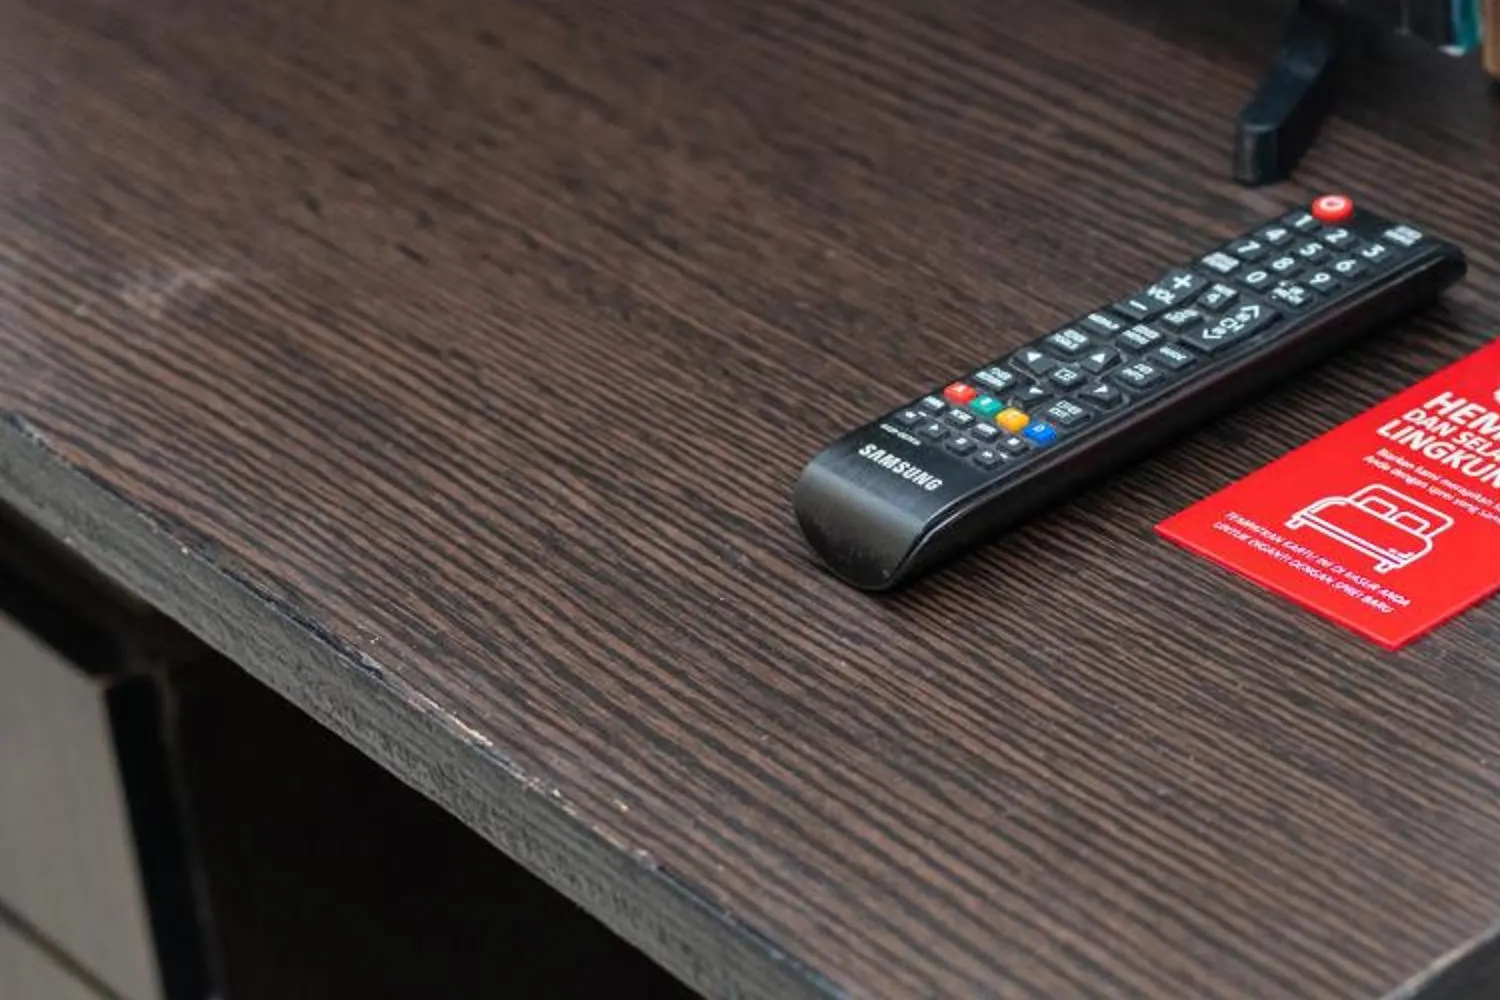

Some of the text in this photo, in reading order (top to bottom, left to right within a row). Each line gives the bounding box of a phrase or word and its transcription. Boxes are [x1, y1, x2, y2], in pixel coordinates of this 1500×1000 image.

[1295, 214, 1312, 229] 1
[1325, 228, 1349, 243] 2
[1237, 240, 1262, 254] 7
[1300, 242, 1323, 256] 5
[1362, 243, 1386, 258] 3
[1271, 257, 1295, 270] 8
[1335, 259, 1357, 272] 6
[1245, 270, 1268, 284] 0
[1308, 272, 1332, 286] 9
[1402, 408, 1459, 436] DAN
[858, 443, 943, 491] SAMSUNG
